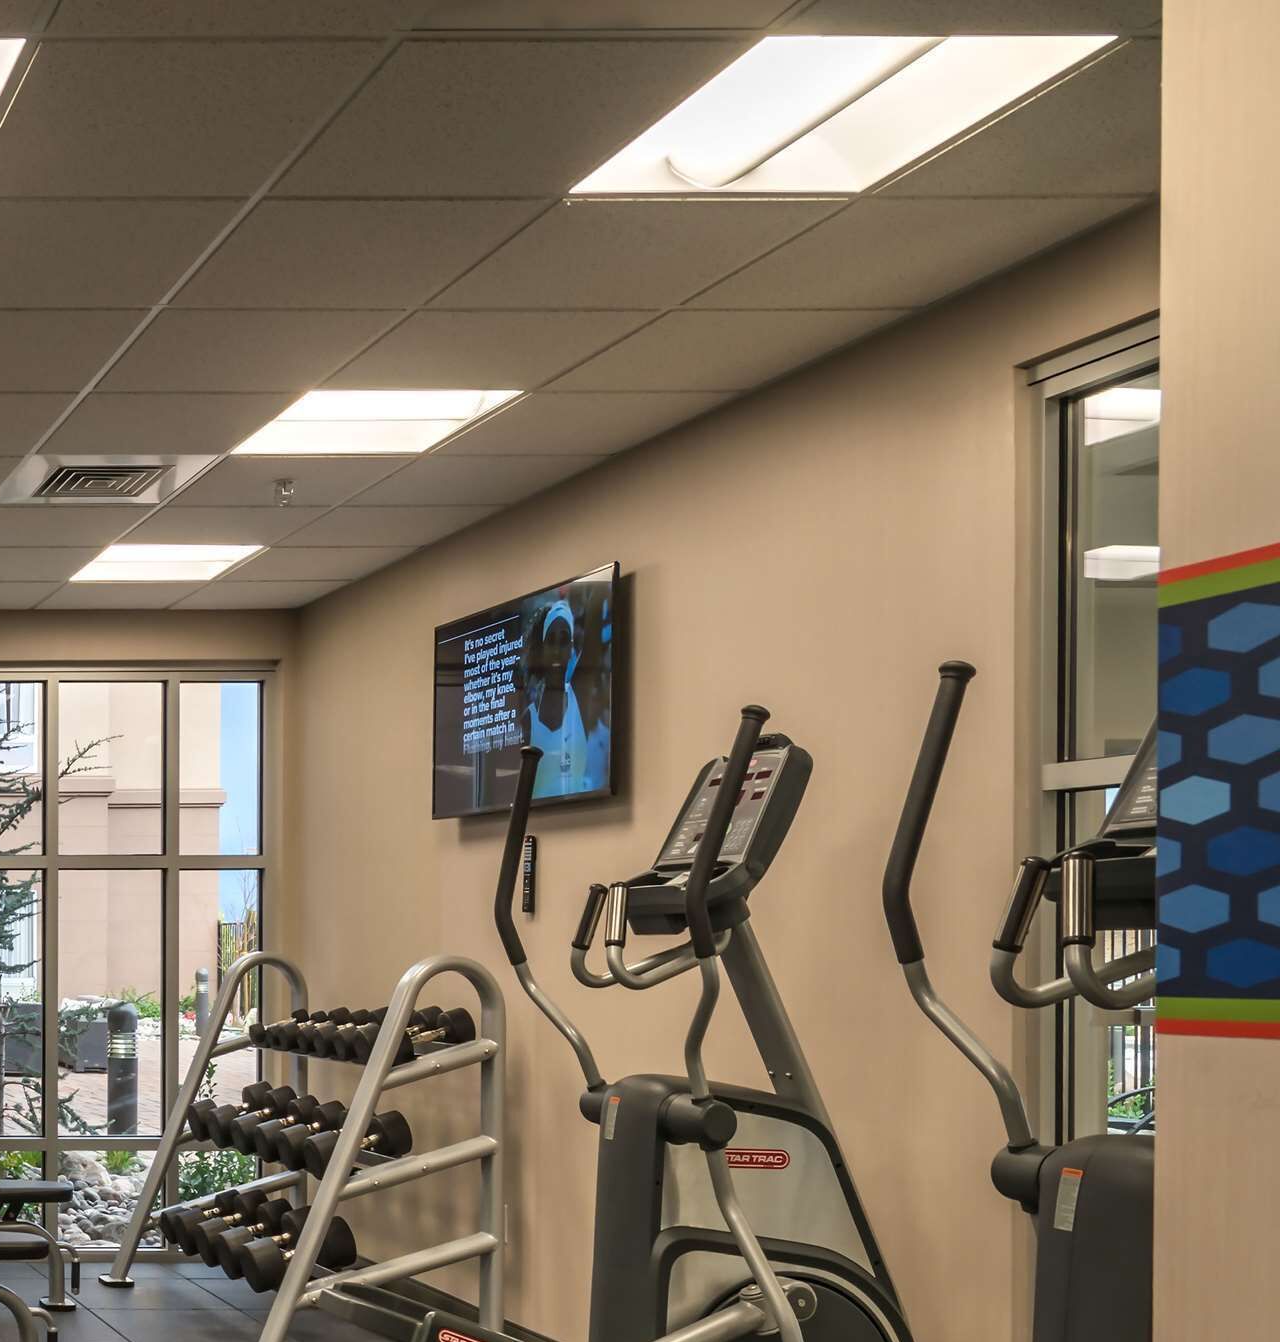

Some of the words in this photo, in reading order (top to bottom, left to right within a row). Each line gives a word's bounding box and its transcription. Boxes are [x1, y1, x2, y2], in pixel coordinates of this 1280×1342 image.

[464, 640, 475, 651] It's
[475, 638, 484, 648] no
[484, 630, 505, 644] secret
[464, 653, 476, 665] I've
[476, 643, 498, 664] played
[499, 636, 523, 655] injured
[464, 664, 481, 678] most
[481, 659, 489, 673] of
[489, 659, 501, 671] the
[463, 677, 491, 691] whether
[491, 672, 502, 684] it's
[502, 670, 514, 682] my
[463, 691, 485, 704] elbow,
[485, 688, 497, 701] my
[496, 683, 516, 696] knee,
[463, 706, 471, 717] or
[478, 701, 490, 713] the
[490, 695, 506, 710] final
[463, 714, 494, 729] moments
[494, 710, 511, 722] after
[463, 728, 485, 743] certain
[485, 723, 507, 737] match
[751, 1155, 783, 1163] TRAC
